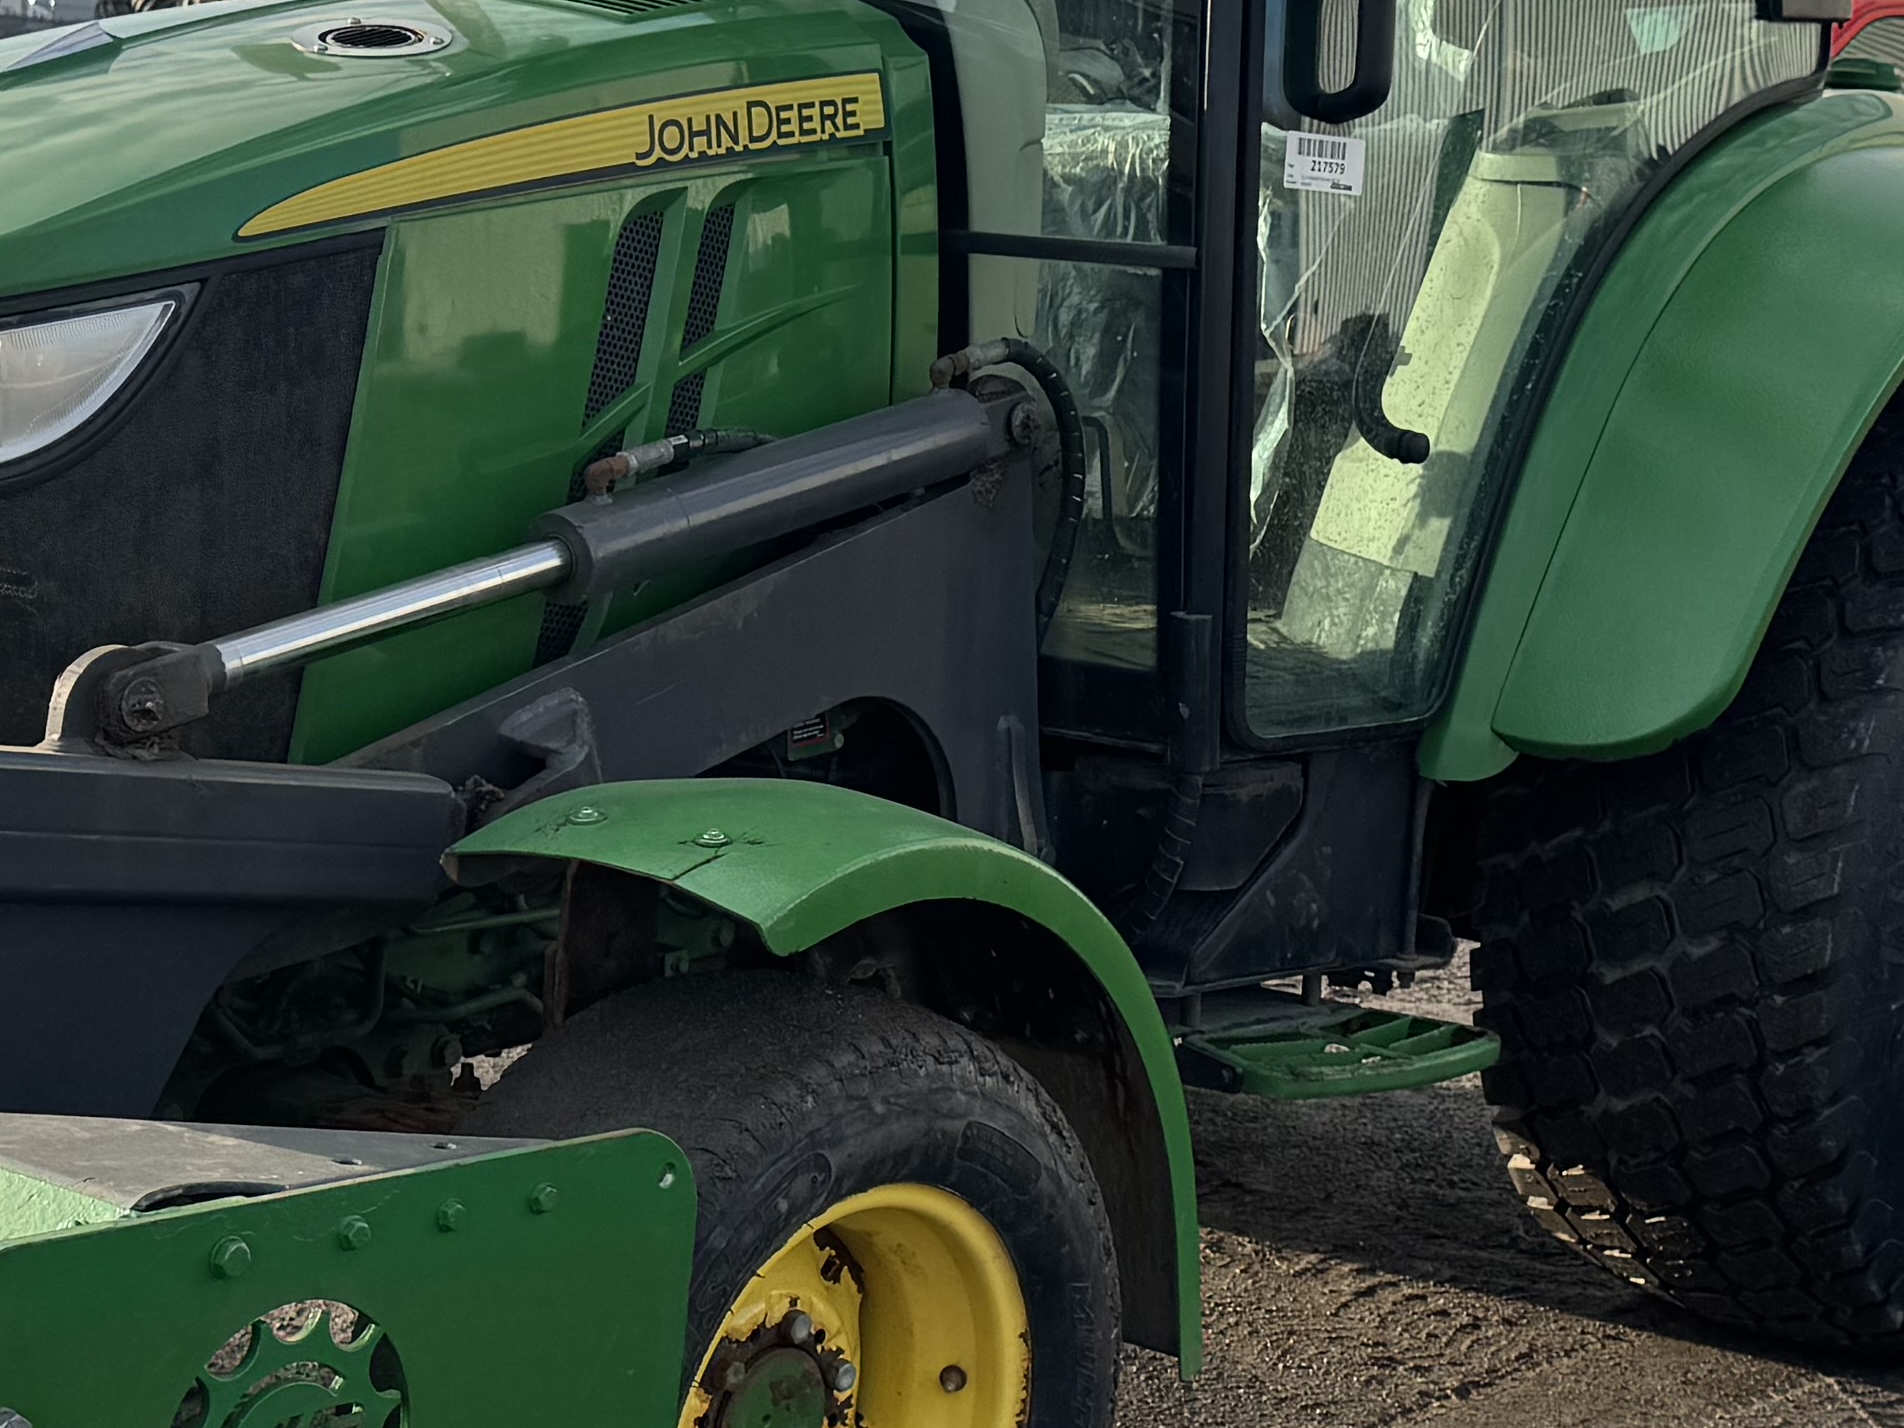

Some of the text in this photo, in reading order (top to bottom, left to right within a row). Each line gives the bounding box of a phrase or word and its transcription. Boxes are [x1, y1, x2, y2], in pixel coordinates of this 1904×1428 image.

[635, 96, 861, 162] JOHN DEERE
[1310, 160, 1346, 175] 217579
